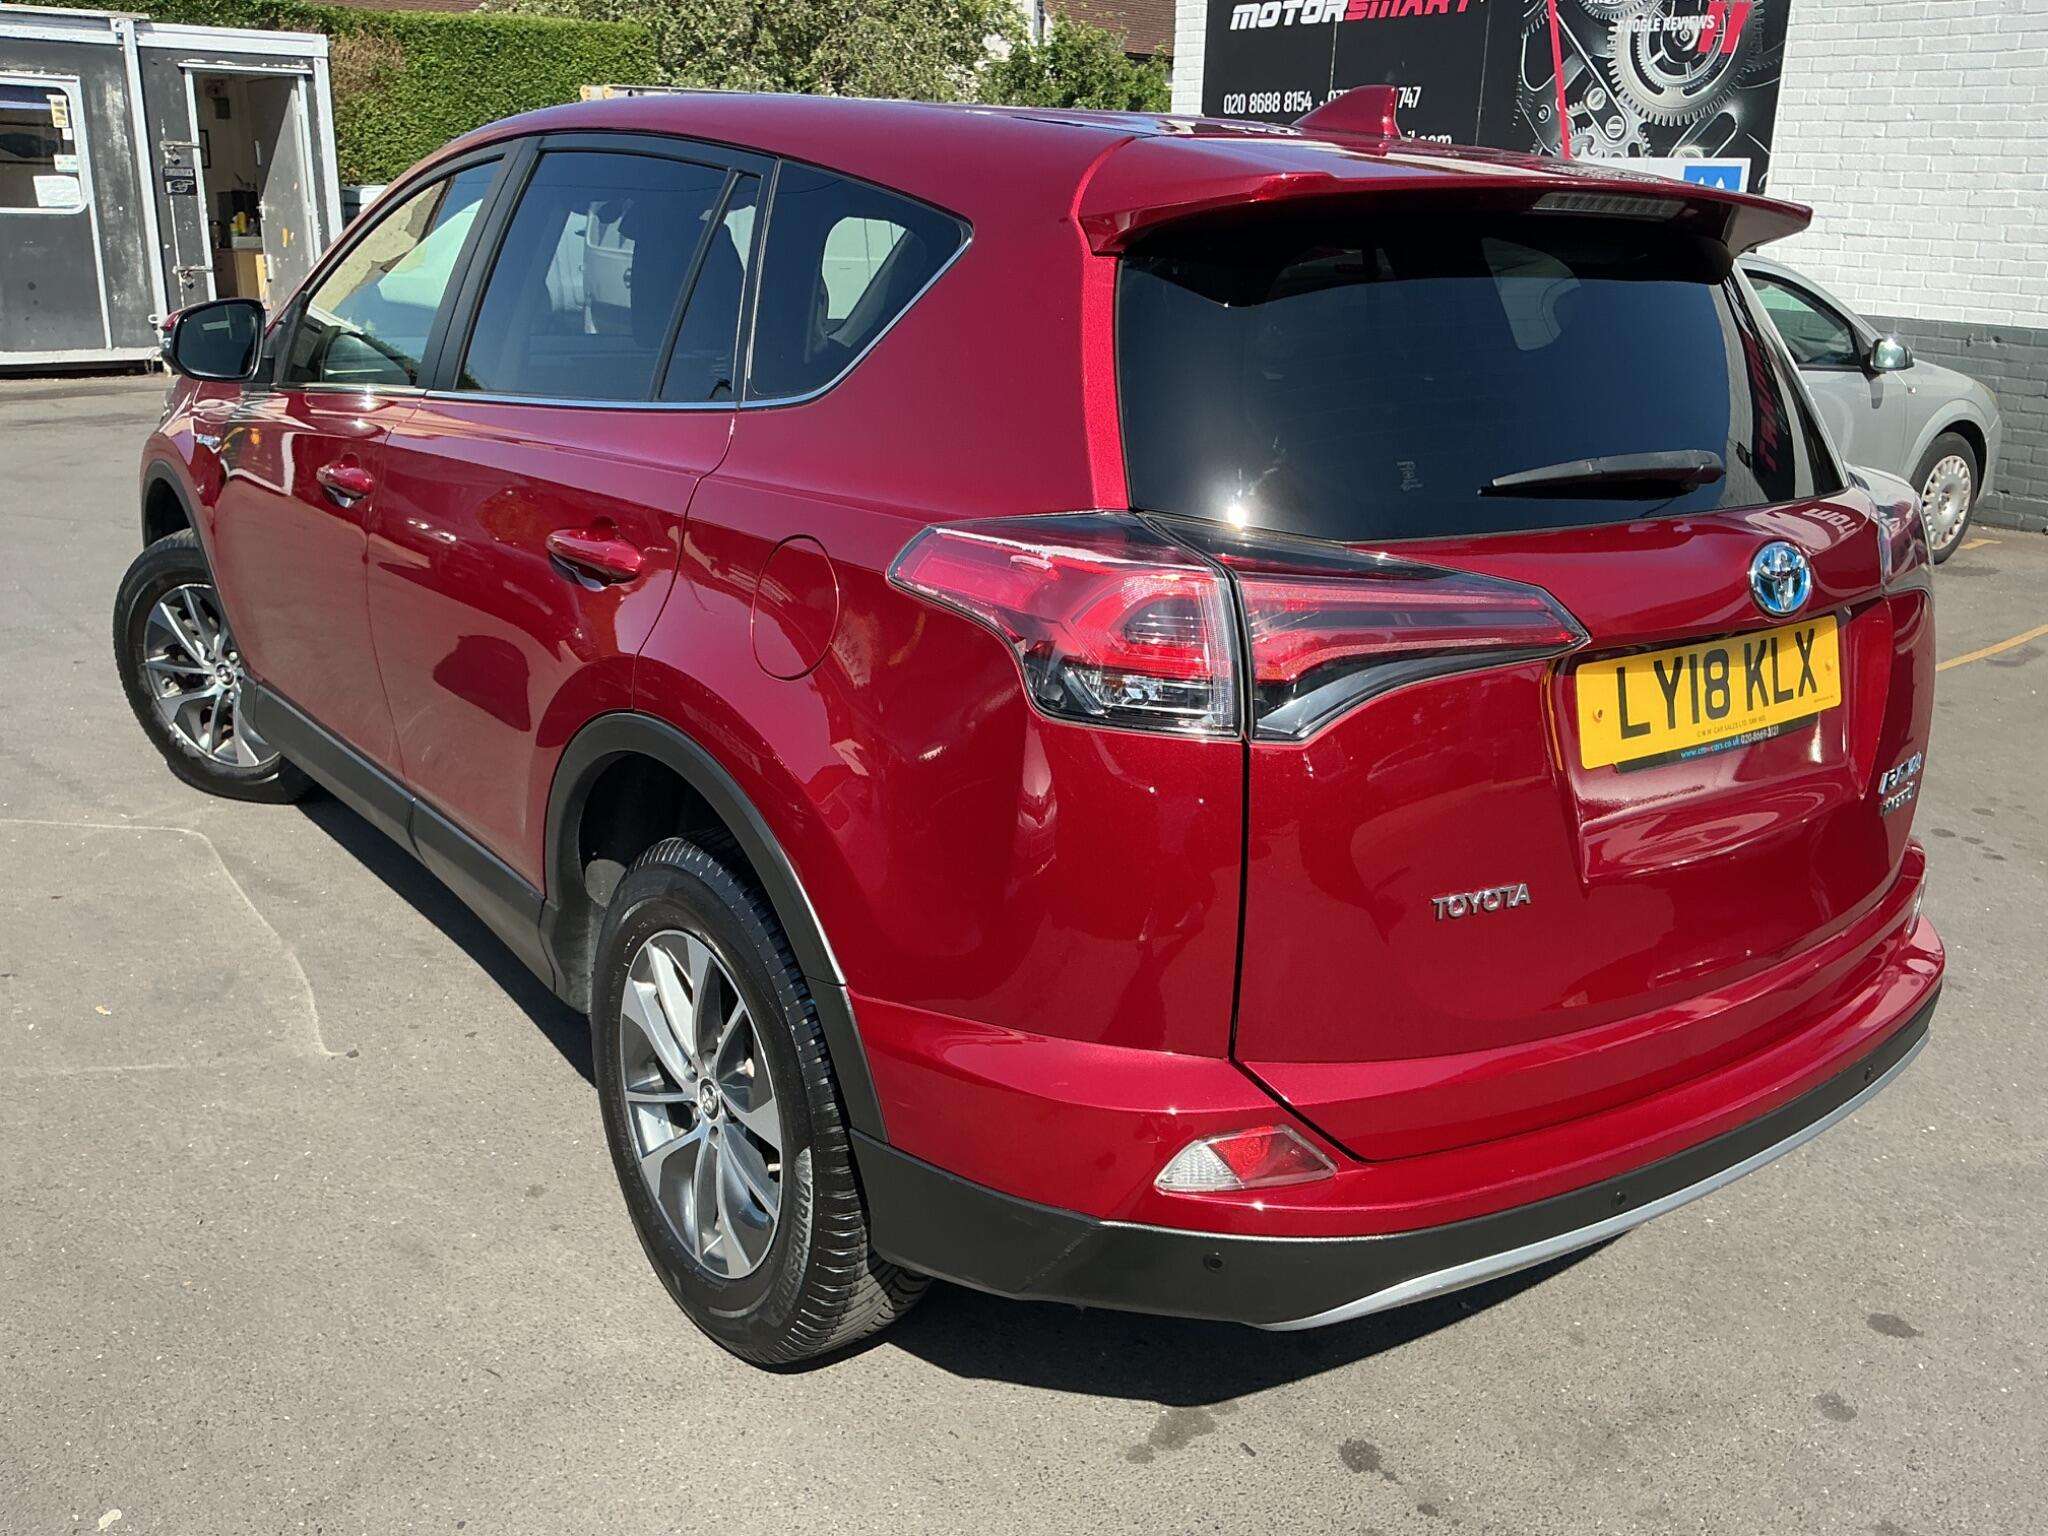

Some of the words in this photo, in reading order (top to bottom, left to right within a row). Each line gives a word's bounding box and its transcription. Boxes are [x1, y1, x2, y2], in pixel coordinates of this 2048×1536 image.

[1618, 17, 1661, 33] GOOGLE
[1663, 15, 1716, 31] REVIEWS
[1223, 93, 1245, 115] 020
[1249, 91, 1281, 114] 8688
[1284, 89, 1313, 112] 8154
[1616, 647, 1732, 740] LY18
[1744, 627, 1818, 712] KLX
[1431, 883, 1532, 920] TOYOTA
